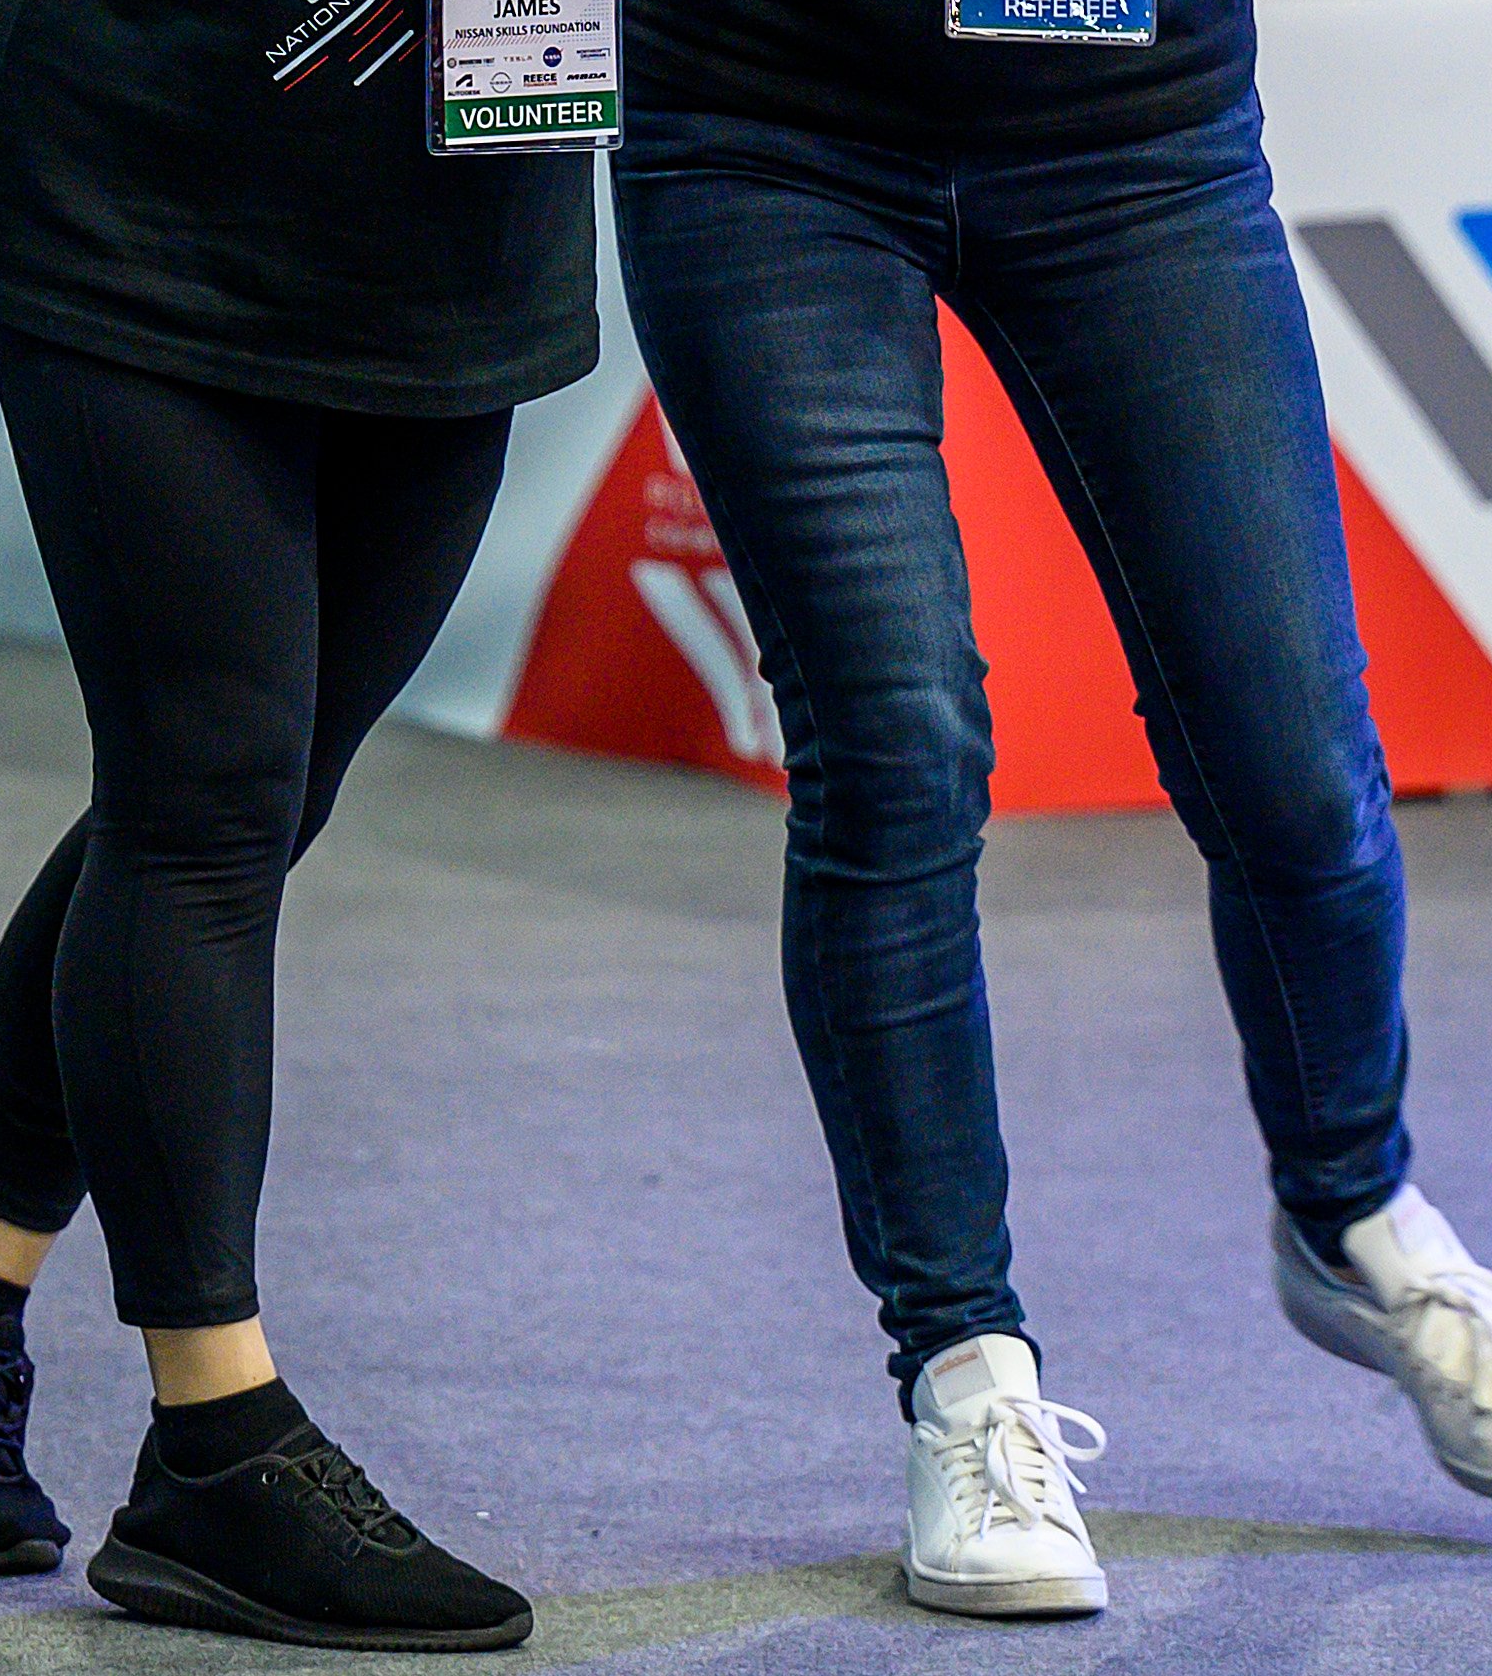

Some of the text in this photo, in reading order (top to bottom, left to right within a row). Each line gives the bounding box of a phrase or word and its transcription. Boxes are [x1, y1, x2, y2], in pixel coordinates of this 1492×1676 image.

[455, 21, 601, 39] NISSAN SKILLS FOUNDATION
[523, 73, 557, 82] REECE
[567, 72, 607, 80] MBDA
[459, 101, 603, 130] VOLUNTEER
